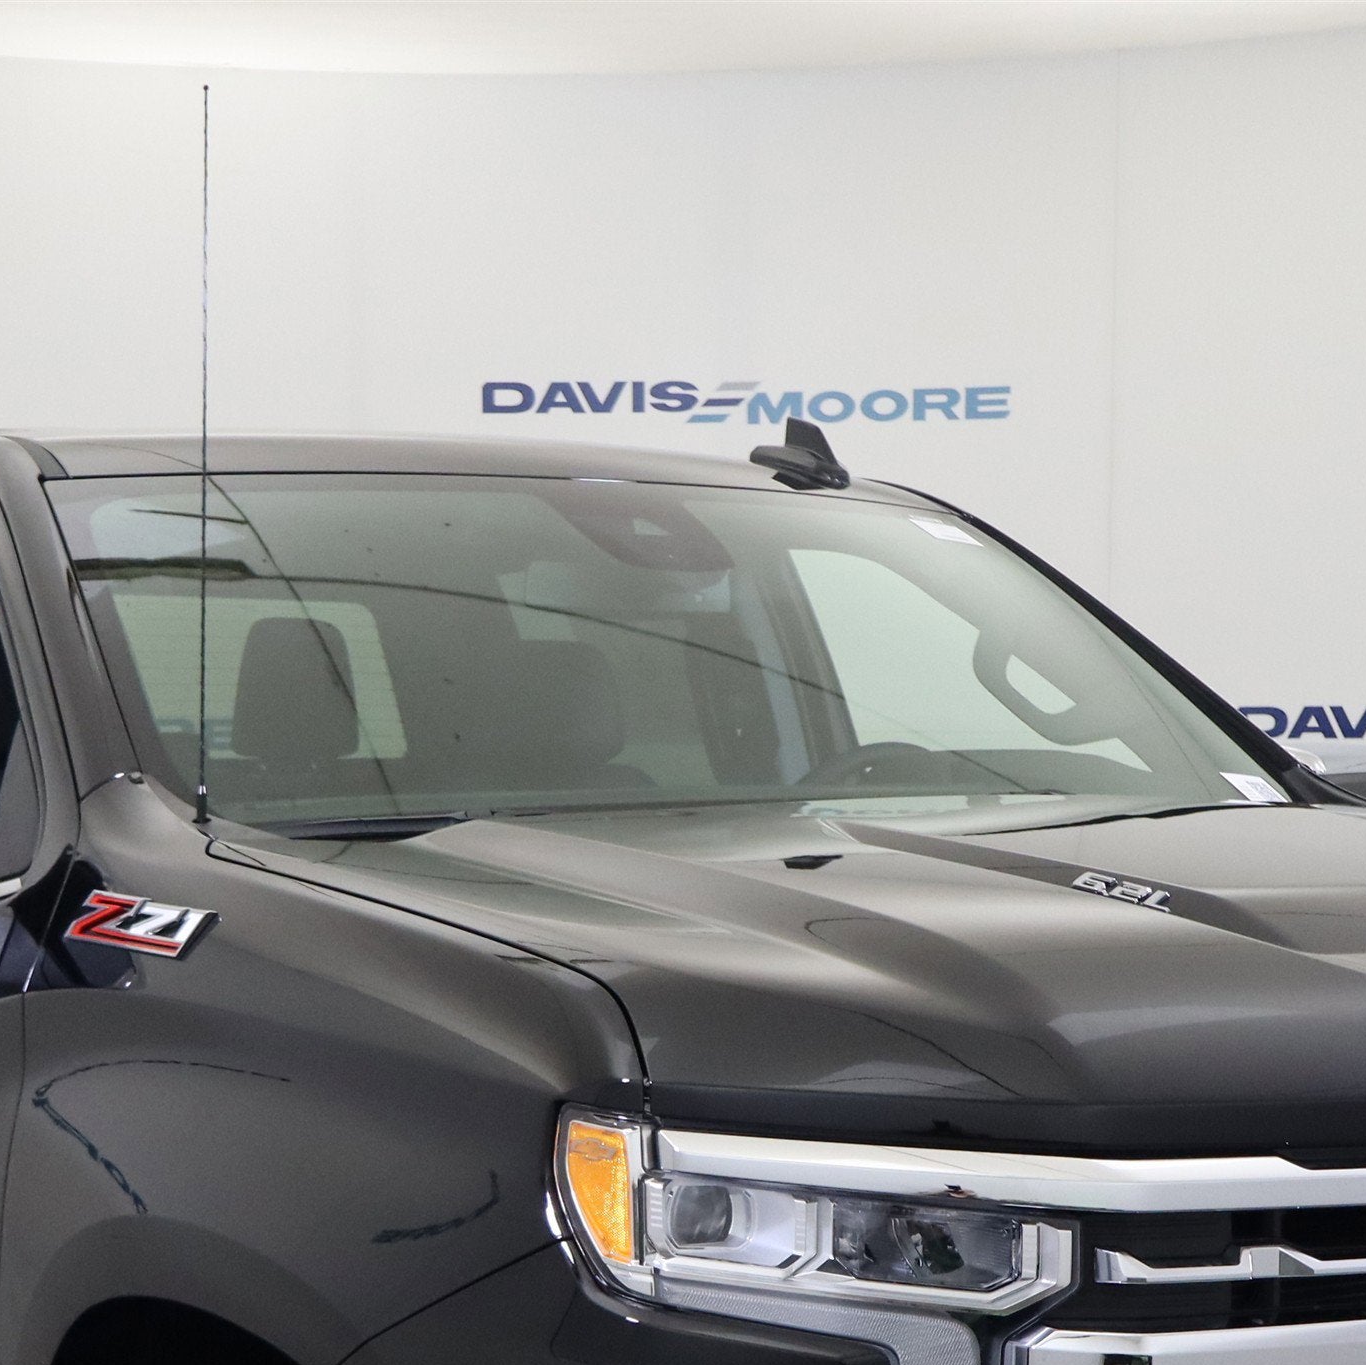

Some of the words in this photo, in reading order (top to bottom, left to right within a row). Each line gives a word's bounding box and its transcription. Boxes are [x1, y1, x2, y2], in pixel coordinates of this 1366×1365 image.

[481, 380, 699, 414] DAVIS
[746, 385, 1011, 425] MOORE
[64, 889, 220, 957] Z71
